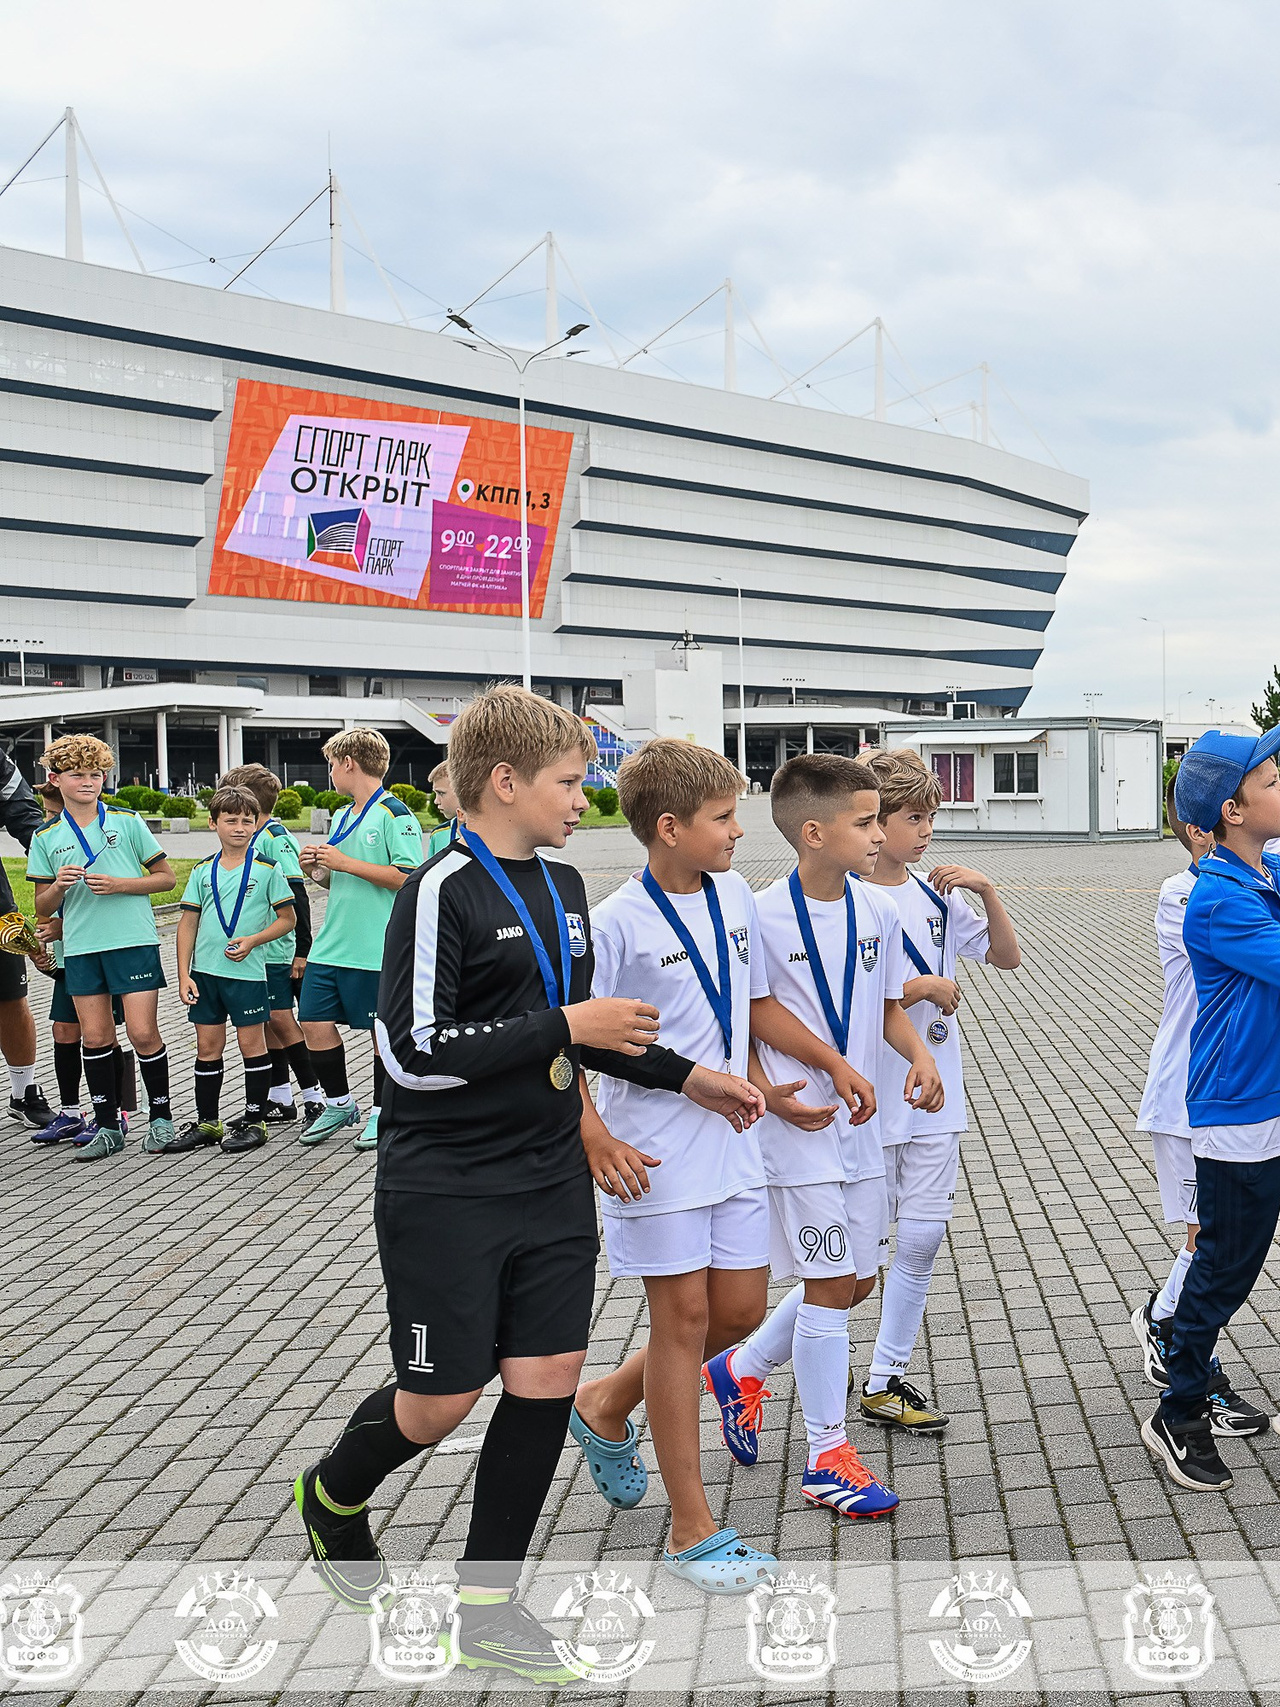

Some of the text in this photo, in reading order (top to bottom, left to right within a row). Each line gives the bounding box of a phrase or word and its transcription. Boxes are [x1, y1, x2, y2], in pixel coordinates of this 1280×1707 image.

[294, 424, 432, 480] СПОРТ ПАРК
[290, 465, 430, 507] ОТКРЫТ
[476, 484, 520, 506] КПП
[539, 492, 550, 510] 3
[368, 537, 404, 559] СПОРТ
[365, 556, 395, 577] ПАРК
[55, 845, 76, 855] KELME
[496, 925, 524, 941] JAKO
[660, 951, 688, 968] JAKO
[788, 951, 810, 963] JAK
[130, 972, 153, 981] KELME
[243, 1006, 265, 1015] KELME
[798, 1224, 847, 1263] 90
[408, 1323, 434, 1373] 1
